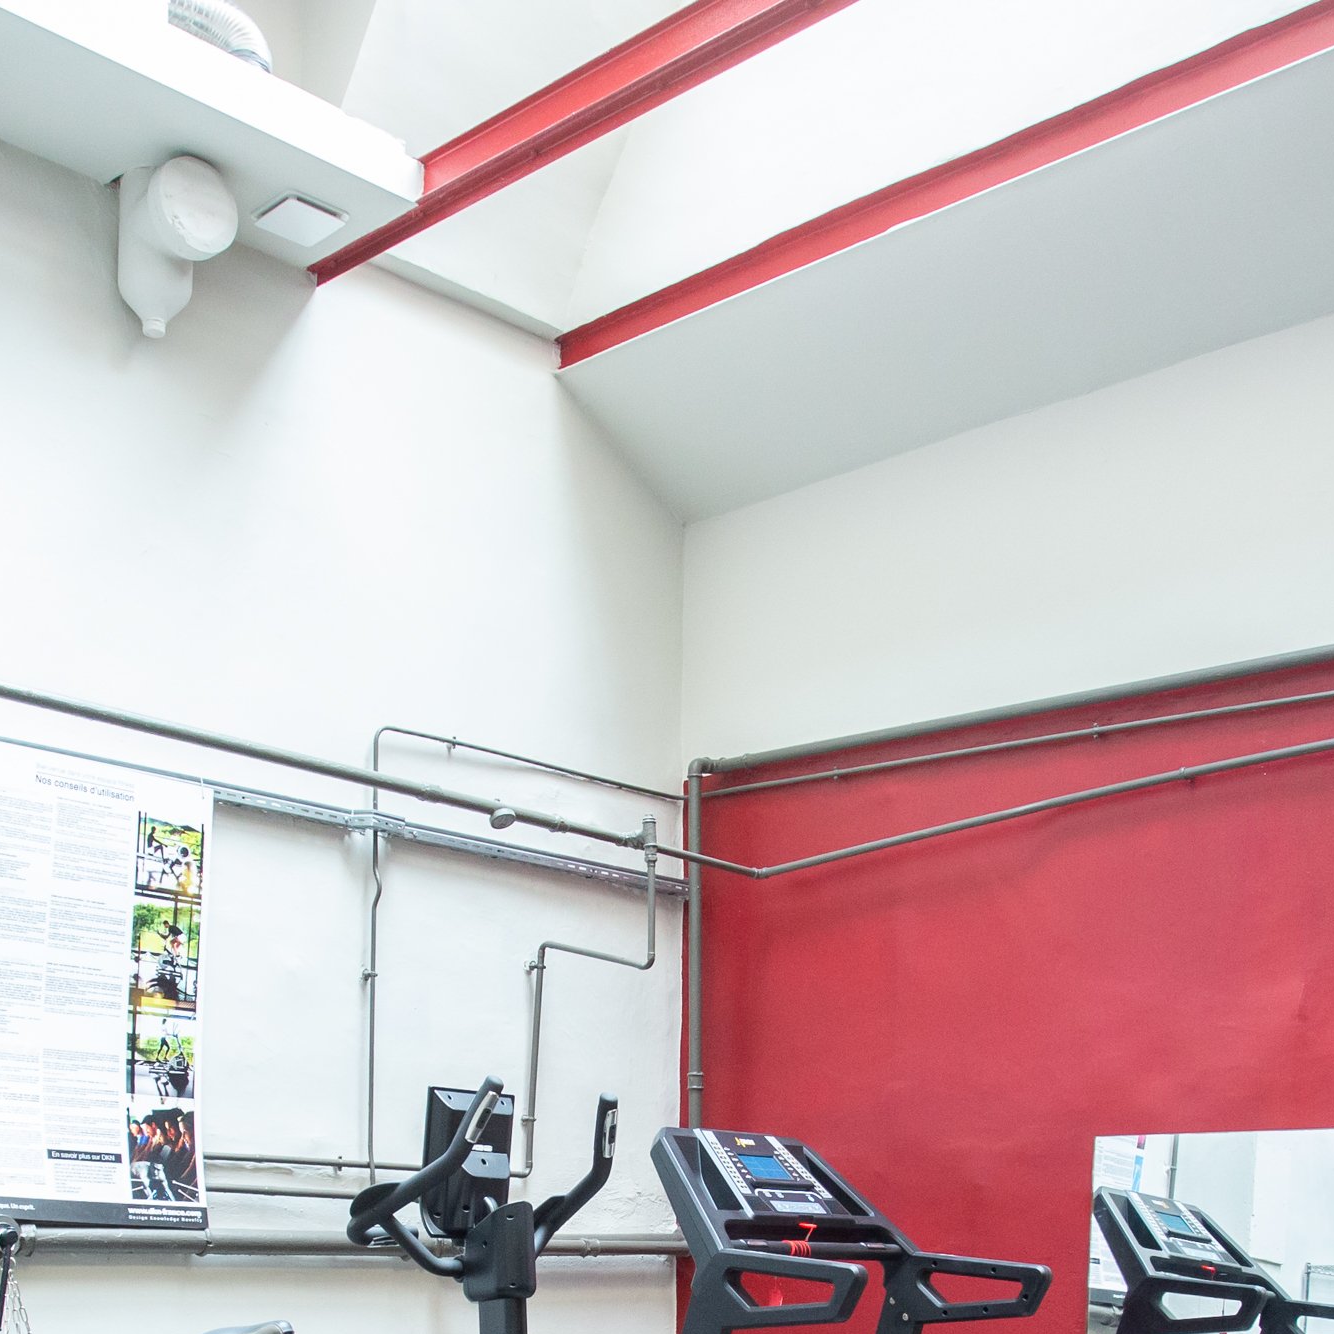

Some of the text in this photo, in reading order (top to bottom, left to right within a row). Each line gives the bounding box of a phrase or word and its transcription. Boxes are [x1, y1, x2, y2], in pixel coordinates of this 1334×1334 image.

[35, 774, 52, 786] Nos
[54, 780, 88, 793] conseils
[52, 1150, 60, 1158] En
